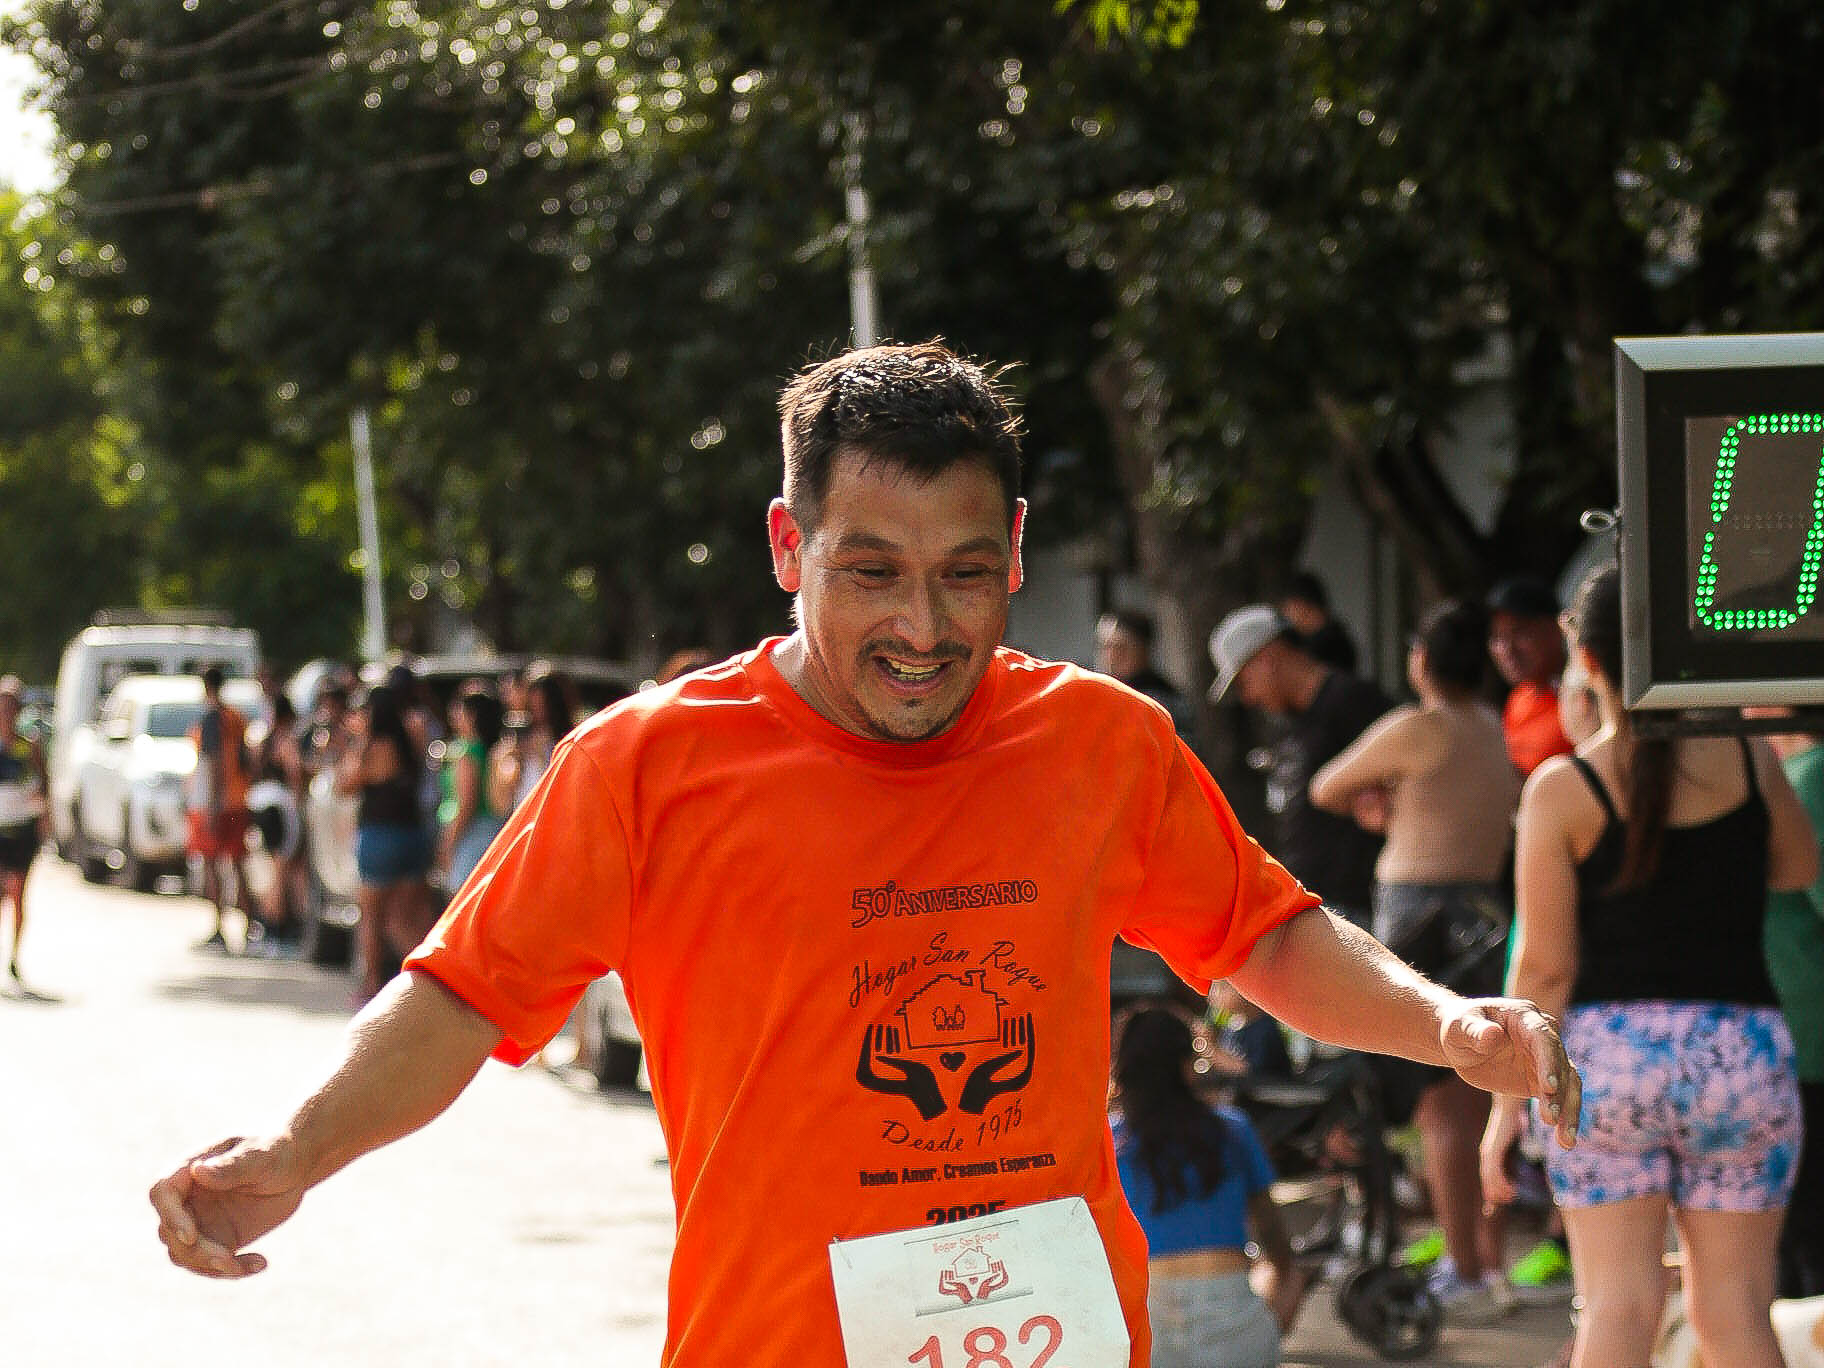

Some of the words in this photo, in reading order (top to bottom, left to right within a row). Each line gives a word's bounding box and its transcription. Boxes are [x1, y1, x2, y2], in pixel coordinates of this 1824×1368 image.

[895, 880, 1038, 916] ANIVERSARIO
[850, 956, 916, 1008] Hogar
[923, 932, 970, 966] San
[979, 940, 1048, 991] Roque
[882, 1120, 964, 1152] Desde
[977, 1098, 1023, 1146] 1975
[943, 1160, 998, 1179] Creamos
[1000, 1153, 1056, 1175] Esperanza
